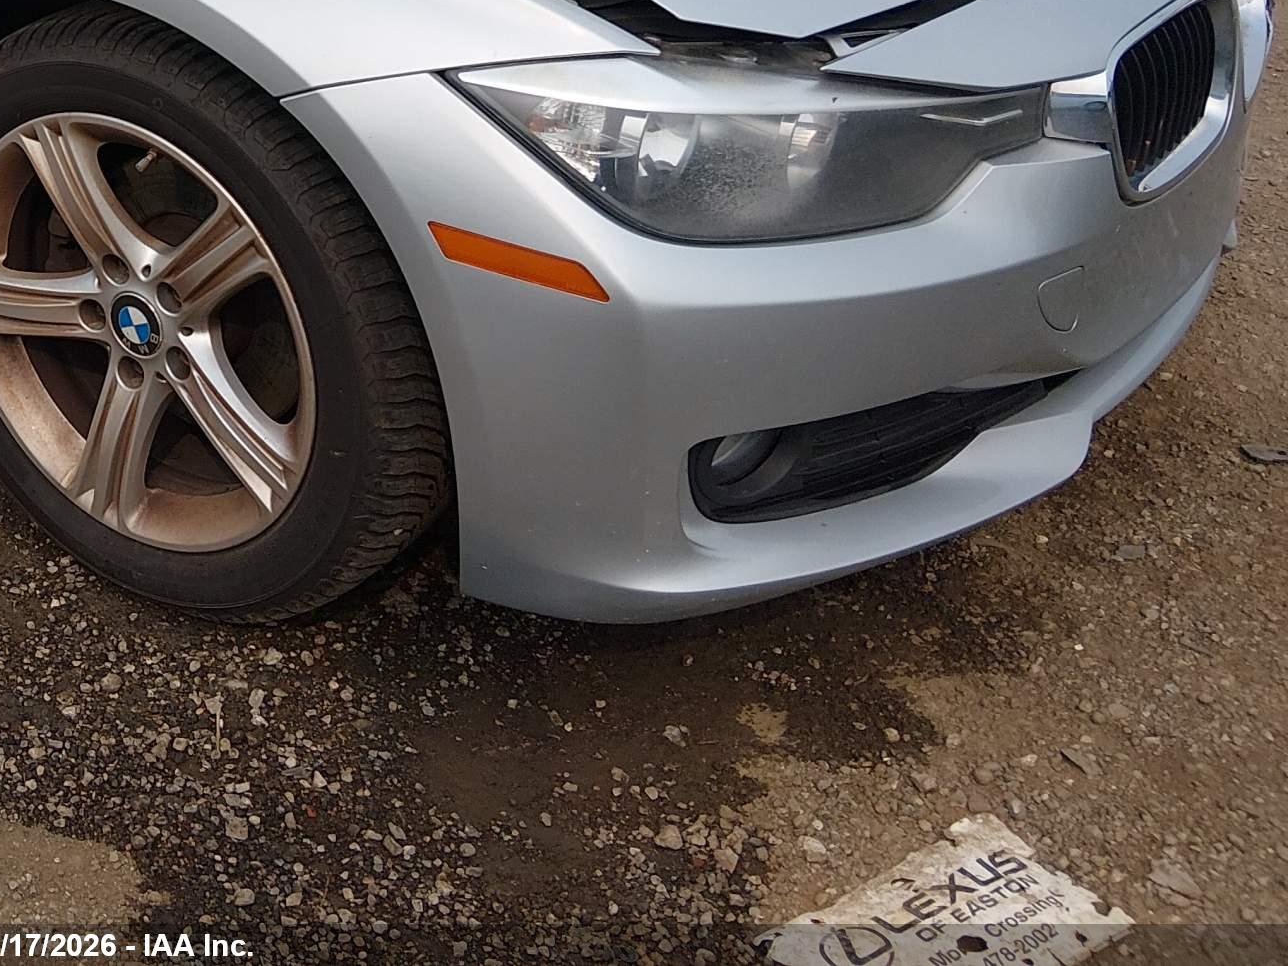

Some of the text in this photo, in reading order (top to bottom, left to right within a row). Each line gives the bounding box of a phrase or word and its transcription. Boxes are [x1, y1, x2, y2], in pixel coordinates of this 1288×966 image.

[872, 848, 1029, 934] LEXUS
[915, 873, 1041, 943] OF EASTON
